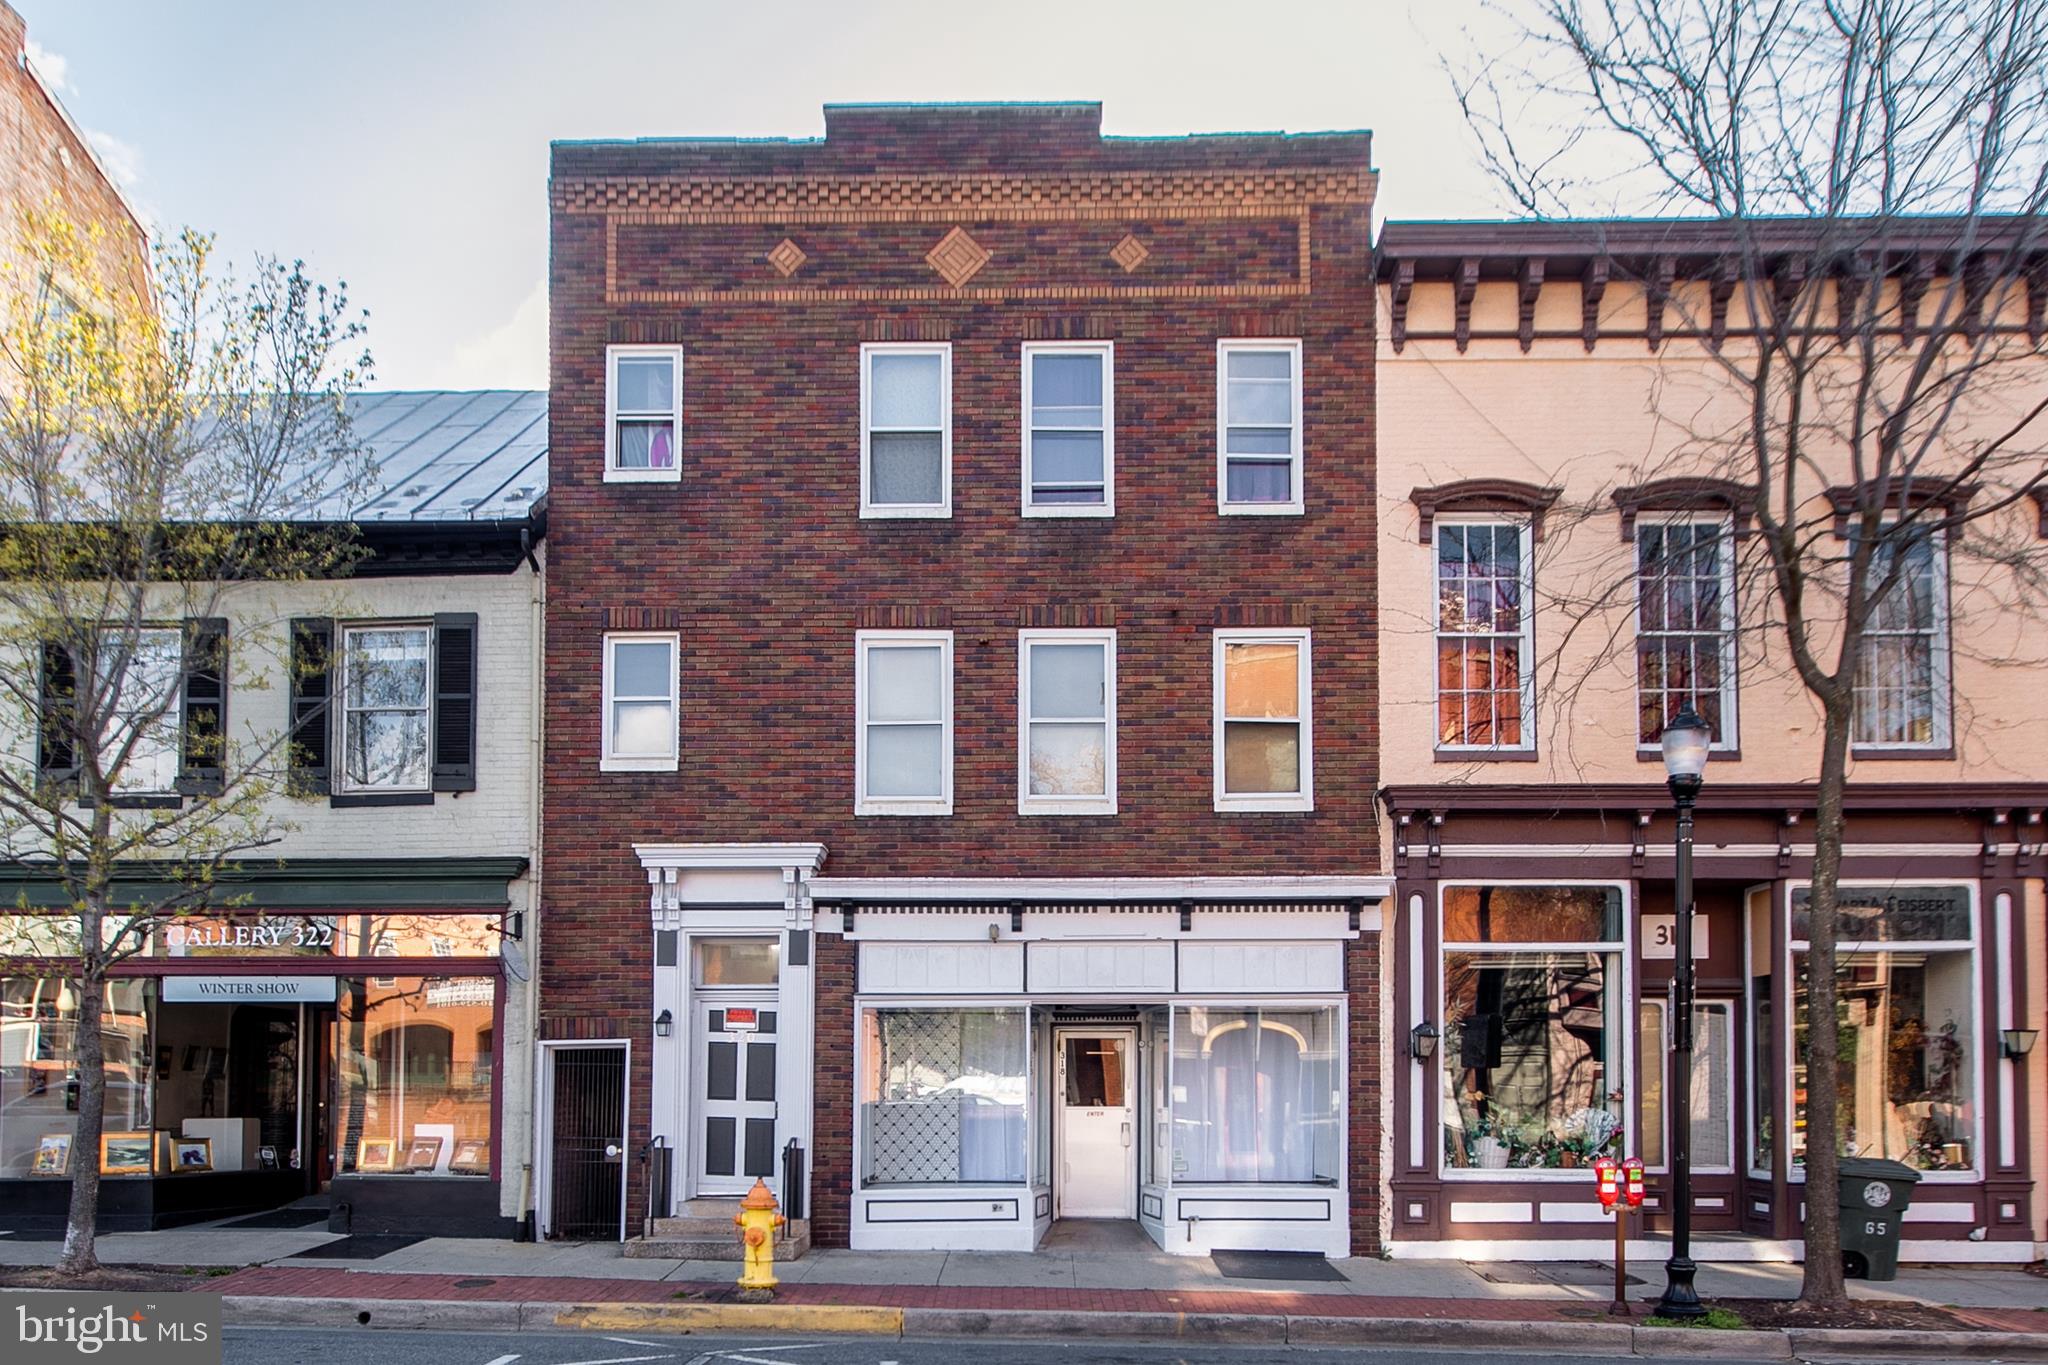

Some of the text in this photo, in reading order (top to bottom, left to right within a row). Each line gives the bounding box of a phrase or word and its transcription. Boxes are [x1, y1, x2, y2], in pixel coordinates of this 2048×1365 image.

[166, 926, 333, 946] GALLERY 322
[1655, 924, 1676, 946] 31
[199, 983, 299, 994] WINTER SHOW
